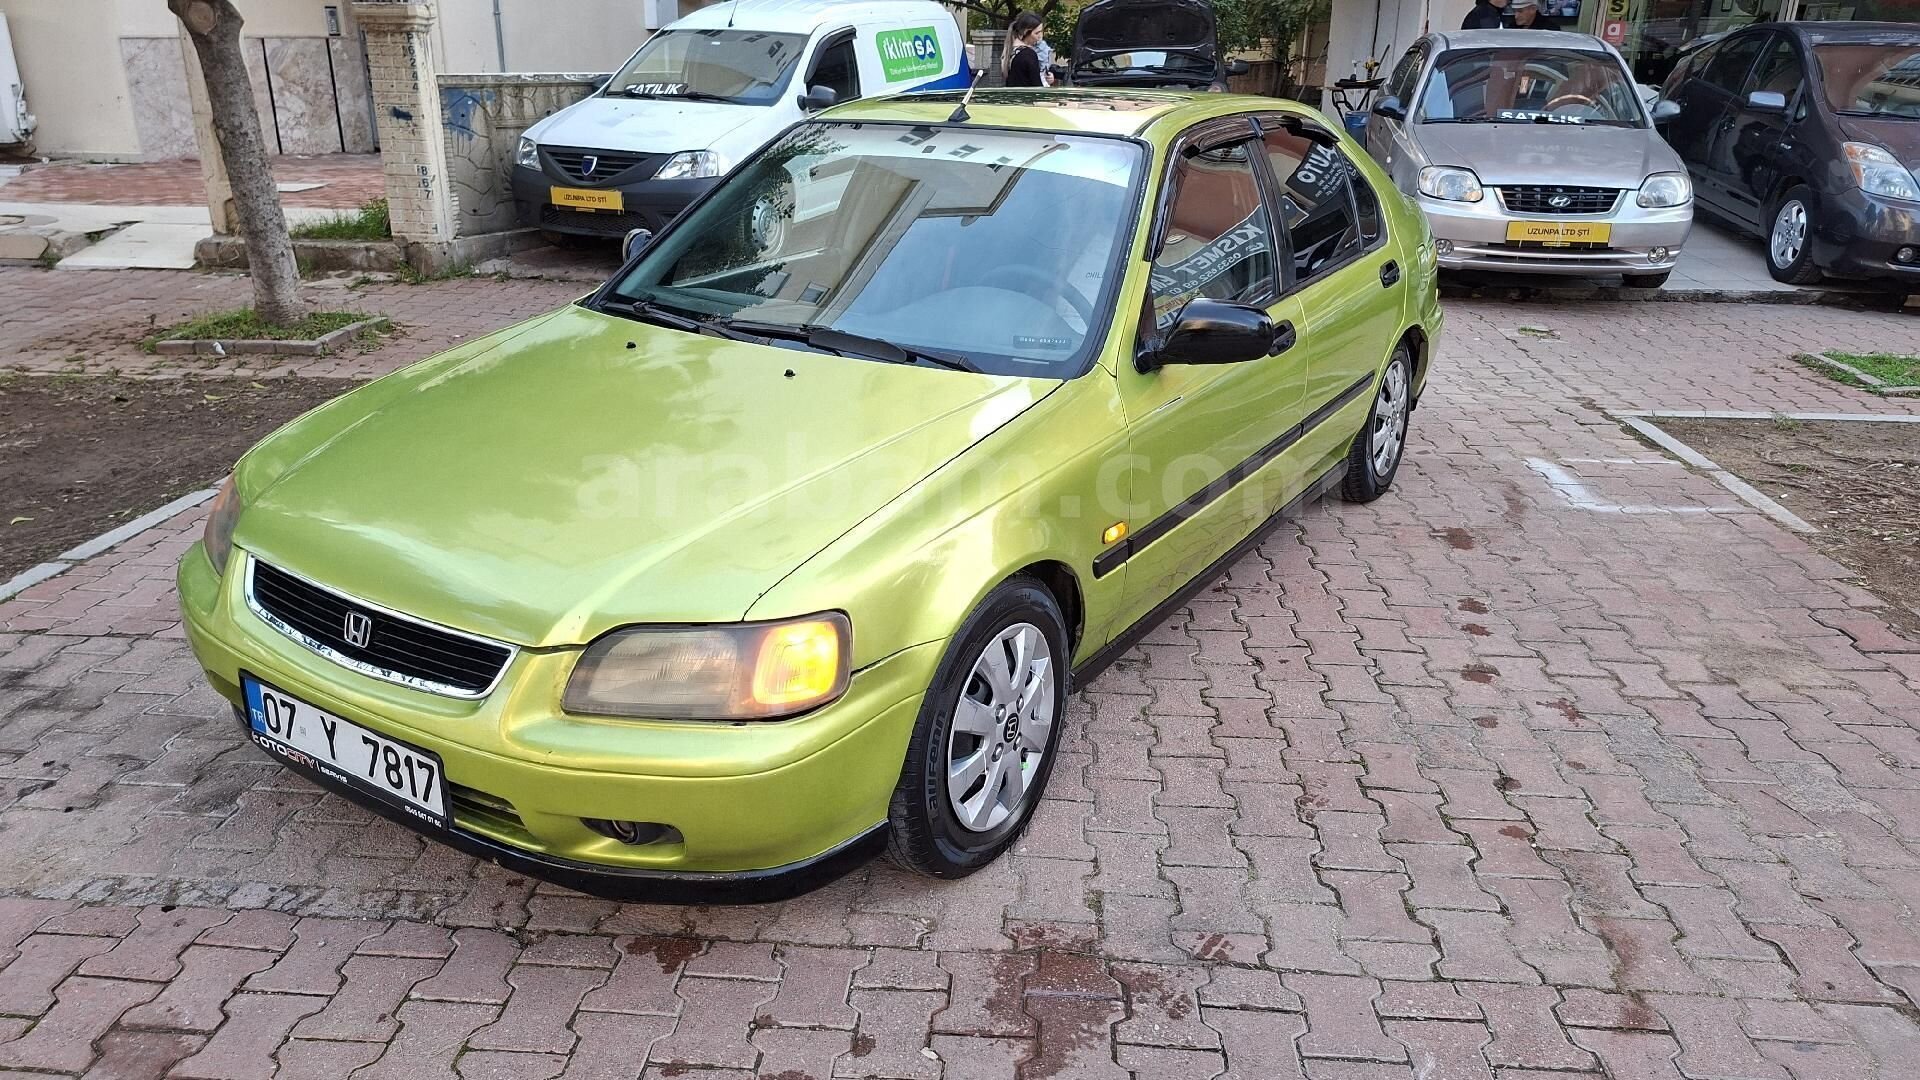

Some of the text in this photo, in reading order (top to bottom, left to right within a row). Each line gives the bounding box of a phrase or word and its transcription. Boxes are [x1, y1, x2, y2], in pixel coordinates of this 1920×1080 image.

[1527, 228, 1560, 236] UZUNPA
[1561, 228, 1576, 236] LTD
[251, 708, 265, 723] TR
[262, 692, 436, 803] 07 Y 7817
